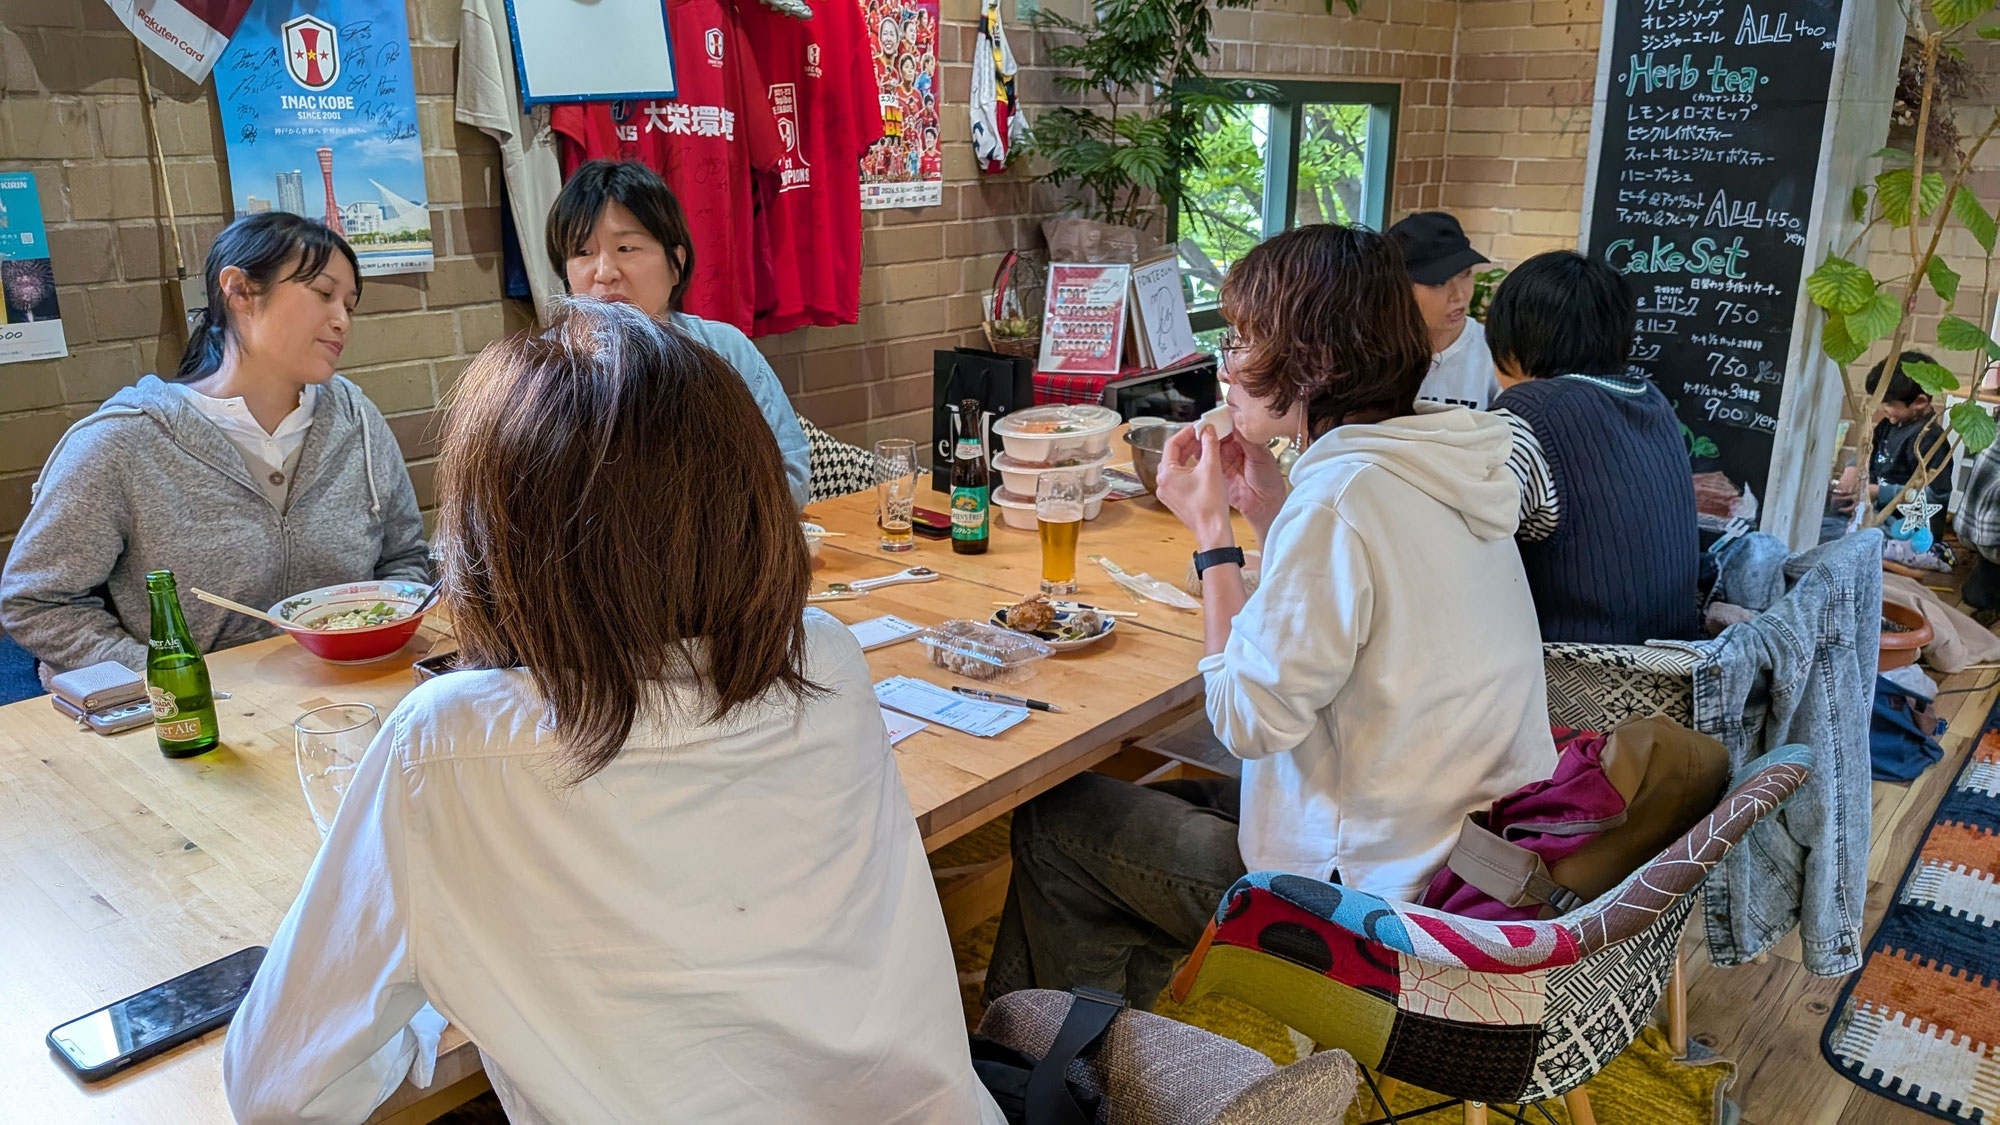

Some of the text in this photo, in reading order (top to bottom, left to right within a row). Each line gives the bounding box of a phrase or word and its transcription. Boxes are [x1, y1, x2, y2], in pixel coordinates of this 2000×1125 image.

[1641, 9, 1724, 30] オレンジソーダ
[1735, 4, 1793, 45] ALL
[1795, 19, 1826, 37] 400
[138, 8, 205, 63] Rakuten Card
[1641, 31, 1725, 51] ジンジャーエール
[1626, 52, 1757, 97] Herb tea
[280, 95, 355, 110] INAC KOBE
[297, 111, 341, 120] SINCE 2001
[644, 101, 735, 141] 大栄環境
[1627, 125, 1734, 143] ピンクルイボスティー
[0, 181, 27, 190] KIRIN
[1620, 167, 1694, 183] ハニーブッシュ
[1704, 189, 1800, 229] ALL 450
[1783, 232, 1806, 247] yen
[1604, 235, 1750, 279] Cake Set
[1714, 301, 1760, 325] 750
[1706, 352, 1748, 377] 750
[1704, 397, 1777, 431] 900 yen
[175, 722, 197, 735] Ale
